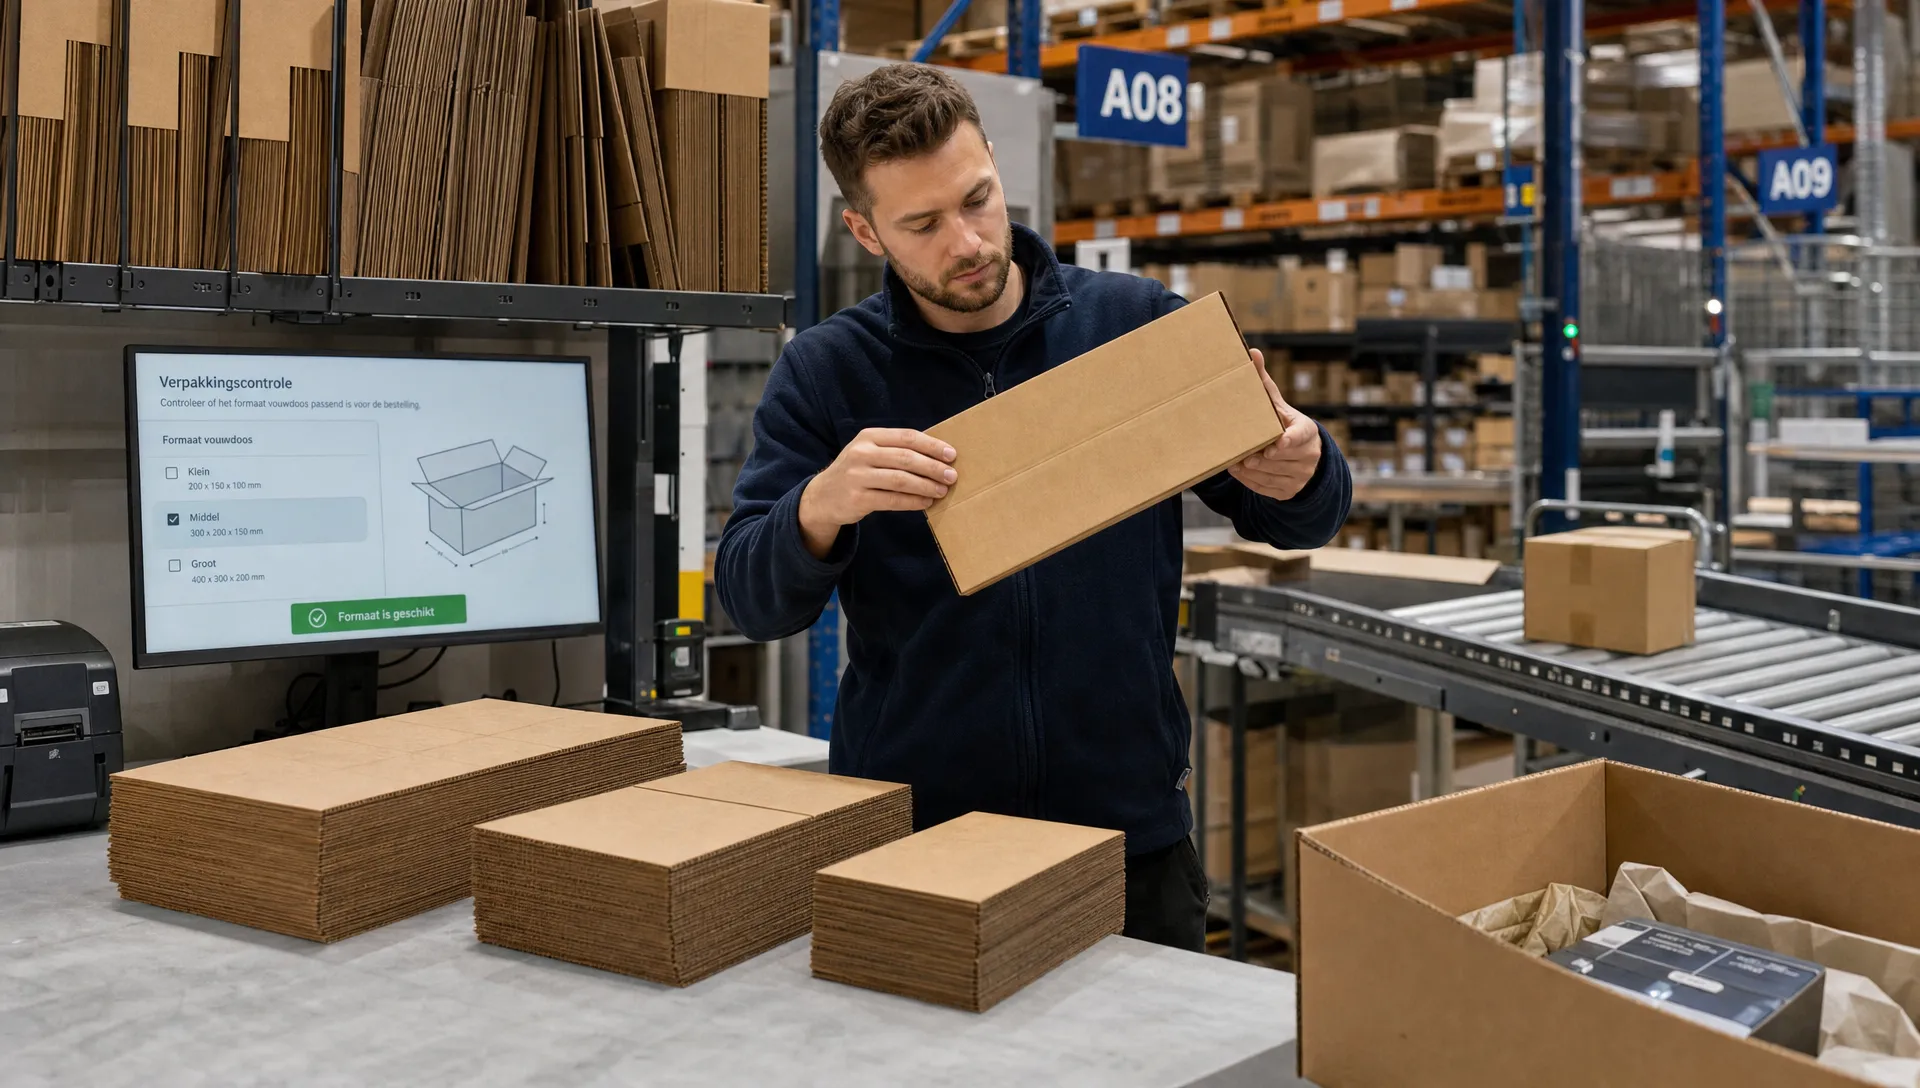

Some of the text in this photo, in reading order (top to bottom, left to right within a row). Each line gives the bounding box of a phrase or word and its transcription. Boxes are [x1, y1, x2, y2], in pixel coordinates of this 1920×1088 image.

[1100, 68, 1183, 125] A08
[1770, 156, 1833, 200] A09
[159, 375, 293, 391] Verpakkingscontrole
[160, 398, 205, 408] Controleer
[207, 398, 216, 408] of
[218, 398, 232, 408] het
[234, 398, 266, 408] formaat
[268, 399, 309, 409] vouwdoos
[311, 399, 344, 411] passend
[345, 400, 352, 409] is
[353, 401, 370, 409] voor
[372, 400, 382, 409] de
[162, 435, 253, 445] Formaat vouwdoos
[188, 467, 210, 476] Klein
[188, 482, 203, 490] 200
[211, 482, 224, 490] 150
[232, 482, 246, 490] 100
[189, 512, 220, 522] Middel
[190, 529, 205, 537] 300
[212, 528, 227, 537] 200
[234, 528, 248, 536] 150
[191, 559, 217, 569] Groot
[191, 575, 206, 584] 400
[213, 574, 228, 583] 300
[235, 574, 250, 582] 200
[338, 607, 435, 622] Formaat is geschikt
